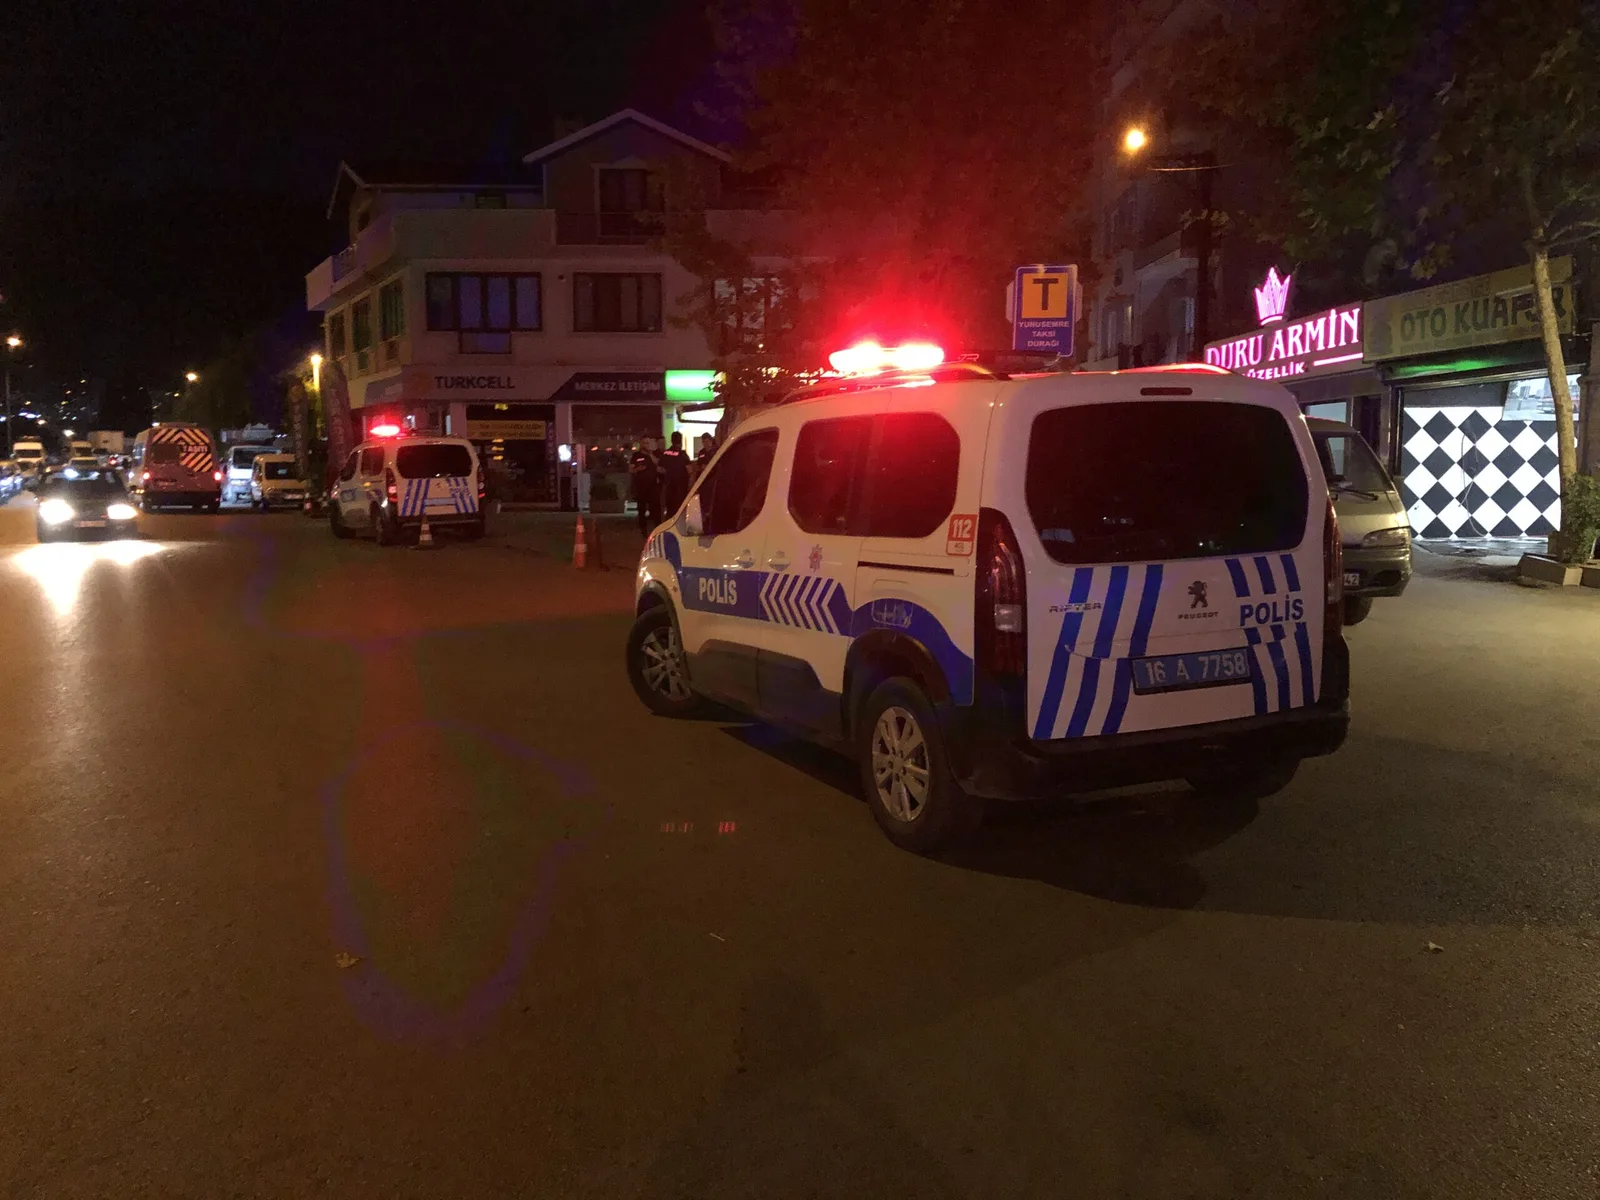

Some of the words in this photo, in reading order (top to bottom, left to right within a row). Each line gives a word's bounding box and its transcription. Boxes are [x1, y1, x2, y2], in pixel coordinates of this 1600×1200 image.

[1032, 278, 1059, 311] T
[1018, 320, 1071, 328] YUNUSEMRE
[1032, 330, 1056, 338] TAKSİ
[1400, 308, 1447, 341] OTO
[1206, 334, 1264, 370] DURU
[1268, 308, 1361, 362] ARMİN
[1242, 361, 1305, 380] ÜZELLİK
[434, 376, 516, 389] TURKCELL
[574, 381, 616, 391] MERKEZ
[618, 380, 661, 394] İLETİŞİM
[952, 518, 972, 539] 112
[698, 573, 738, 605] POLİS
[1049, 602, 1102, 613] RIFTER
[1178, 611, 1219, 620] PEUGEOT
[1240, 594, 1304, 626] POLİS
[1145, 660, 1166, 685] 16
[1176, 658, 1190, 681] A
[1198, 652, 1246, 679] 7758
